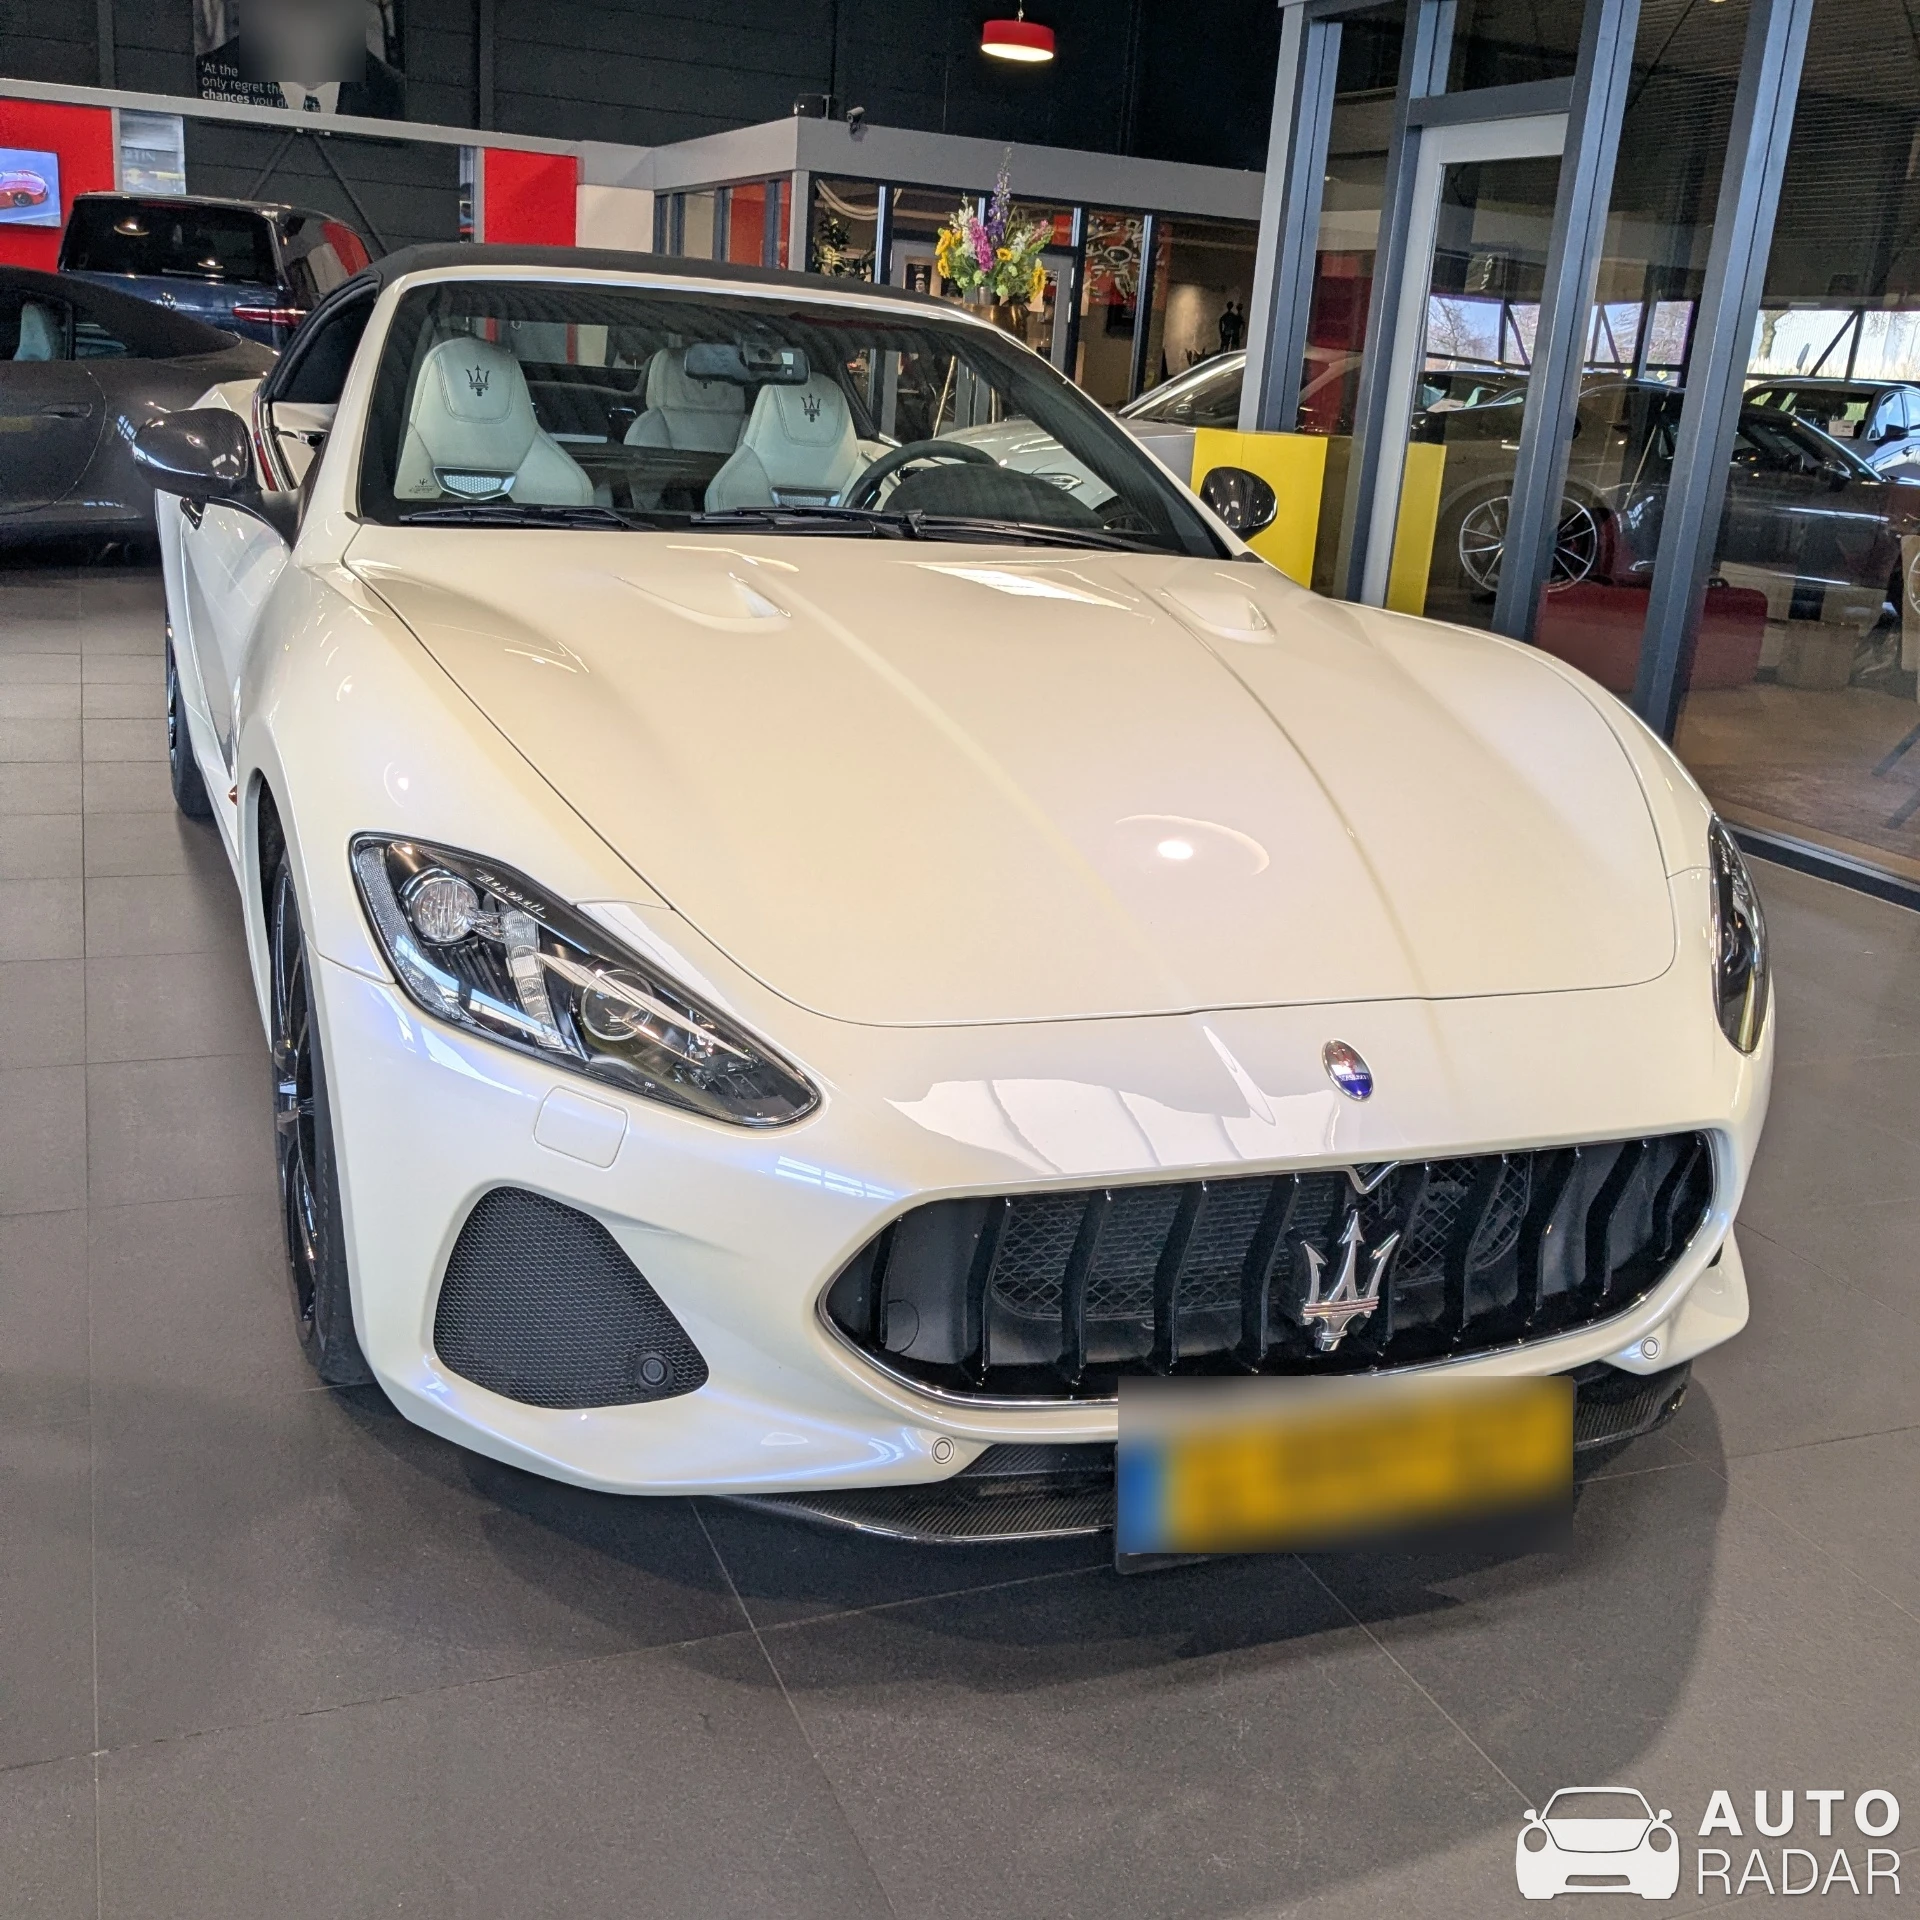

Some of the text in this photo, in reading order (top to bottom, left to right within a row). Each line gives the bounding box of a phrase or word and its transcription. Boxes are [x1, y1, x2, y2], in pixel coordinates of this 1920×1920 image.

[219, 64, 239, 77] the
[202, 76, 227, 90] only
[230, 80, 265, 94] regret
[202, 89, 250, 104] chances
[252, 97, 273, 108] you
